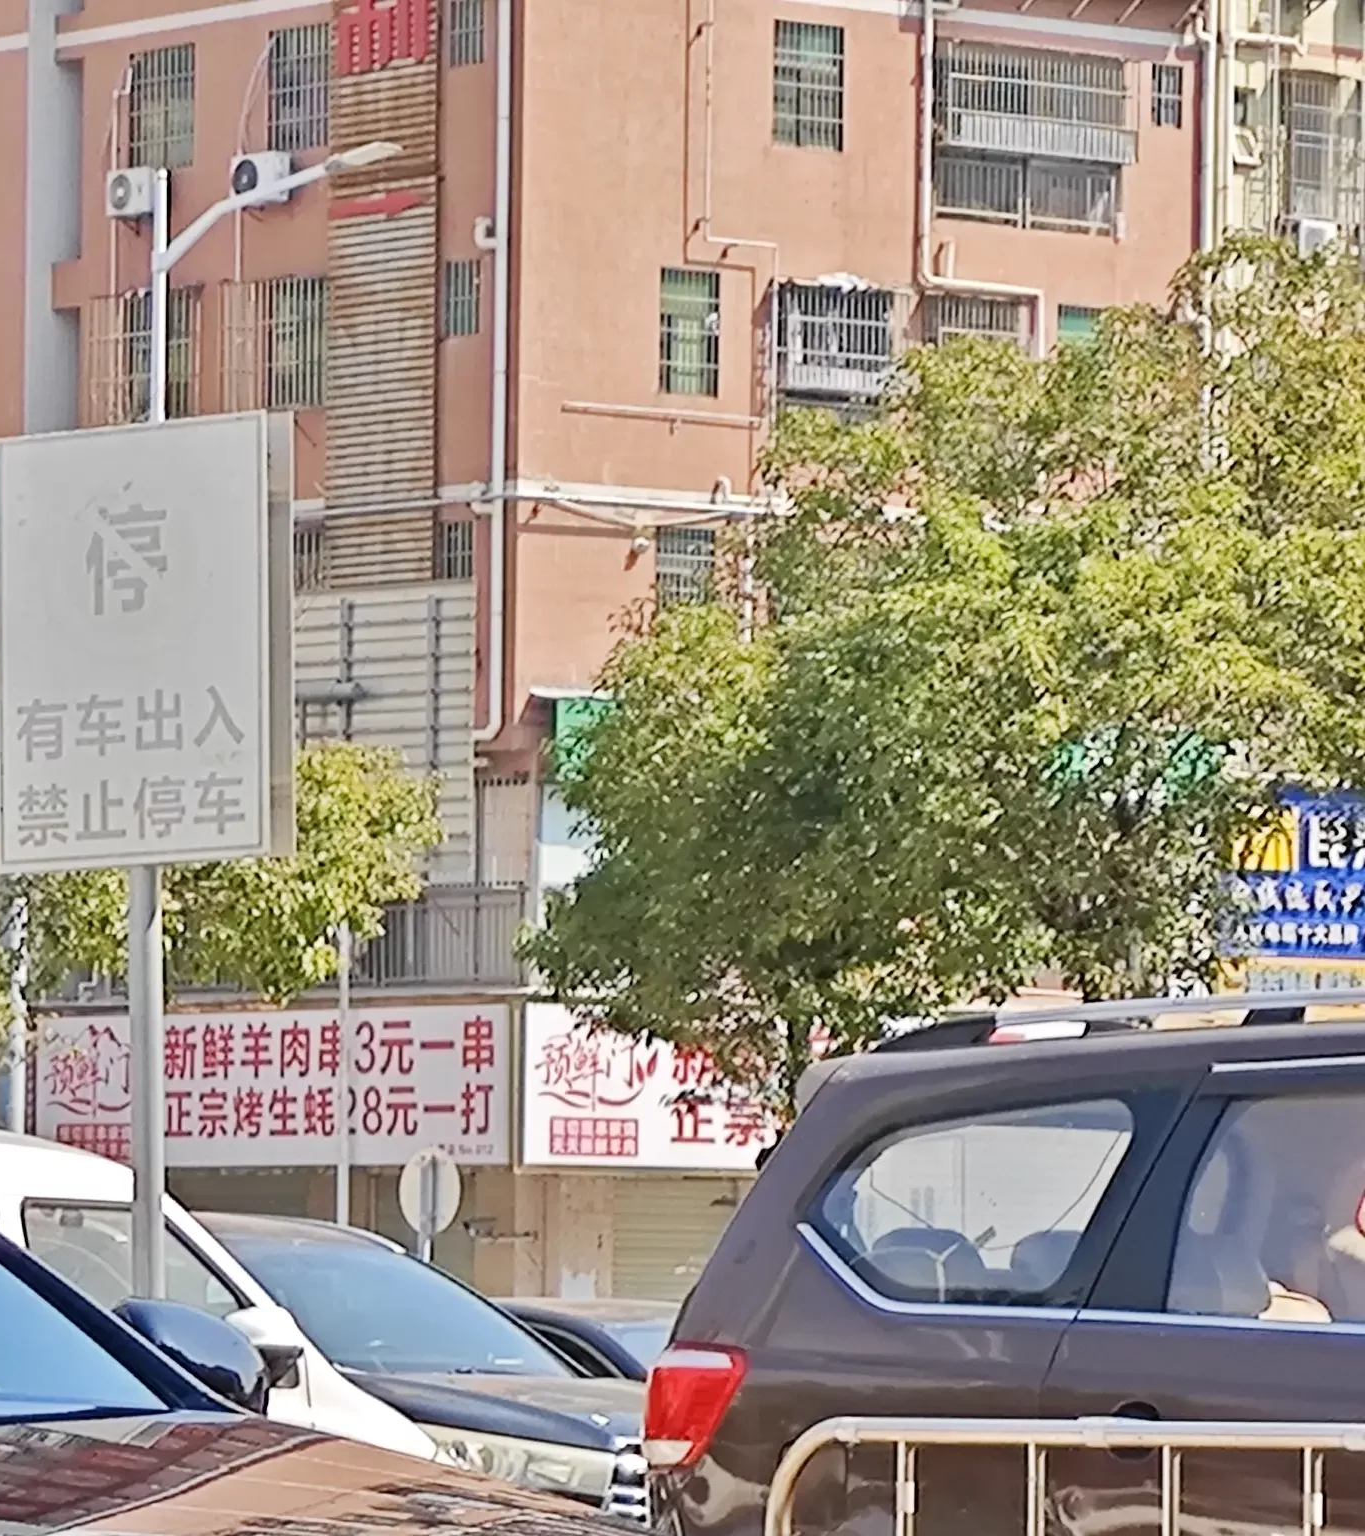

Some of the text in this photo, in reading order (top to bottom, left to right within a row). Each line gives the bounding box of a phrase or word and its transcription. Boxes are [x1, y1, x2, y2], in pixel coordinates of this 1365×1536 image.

[85, 502, 169, 616] 停
[16, 685, 246, 763] 有车出入
[17, 771, 246, 847] 禁止停车
